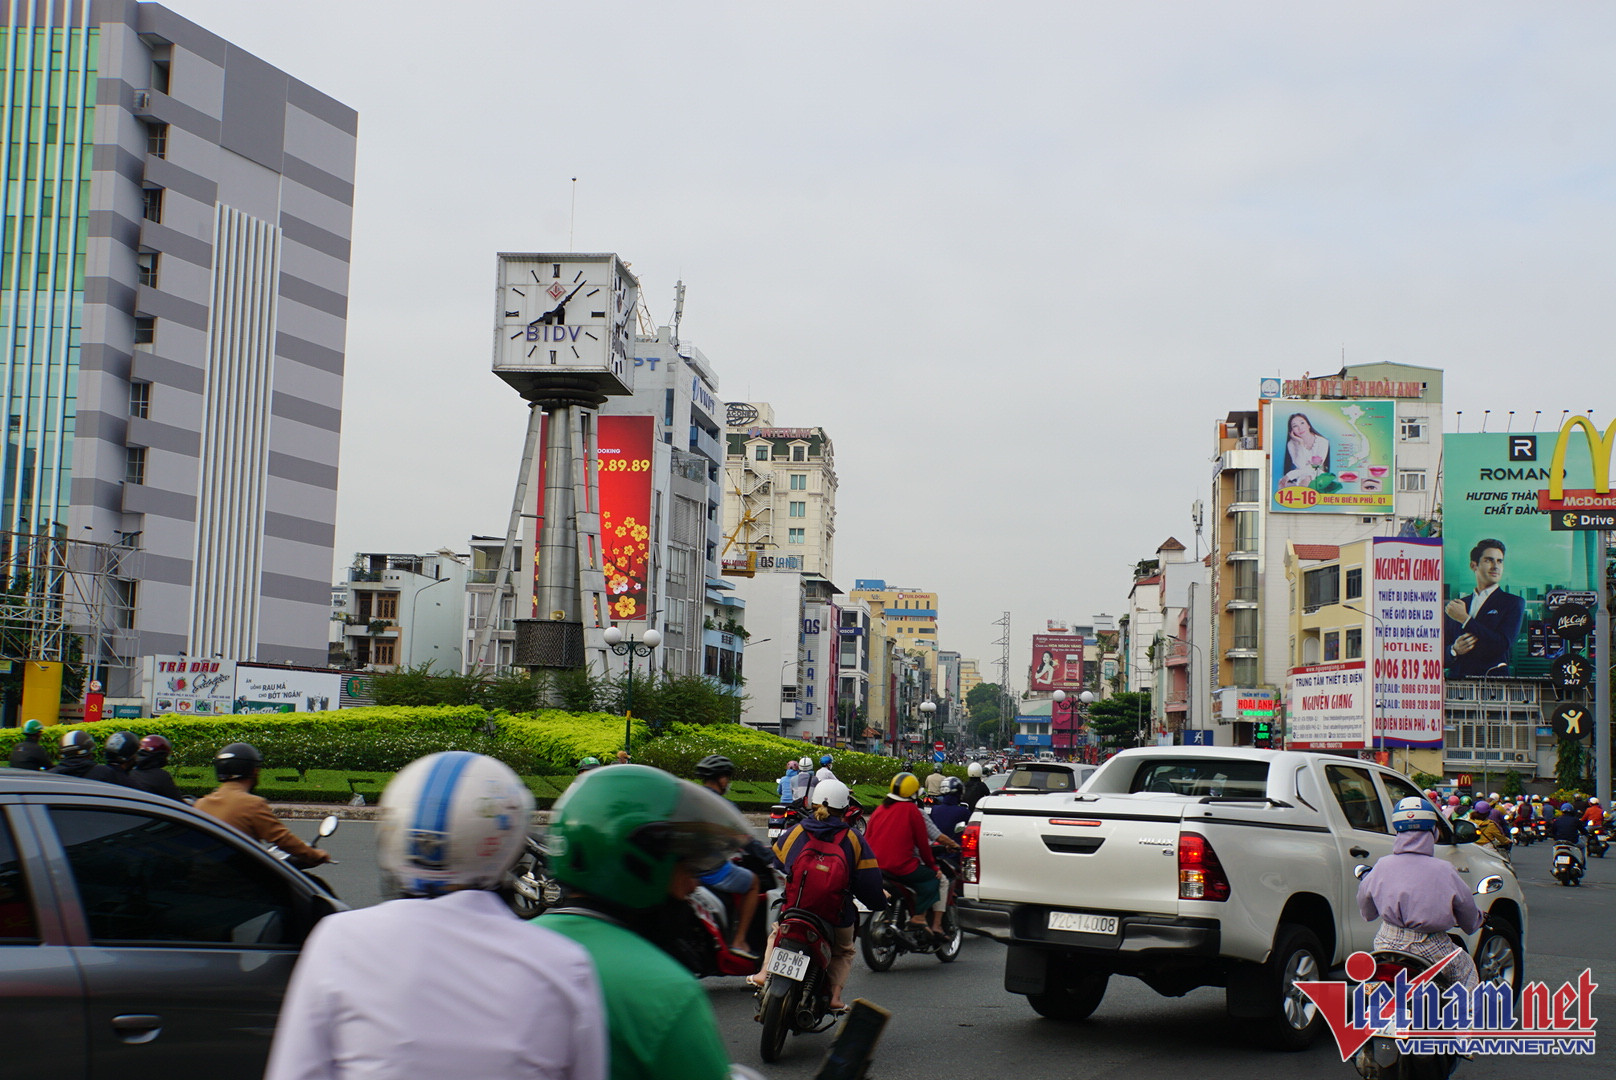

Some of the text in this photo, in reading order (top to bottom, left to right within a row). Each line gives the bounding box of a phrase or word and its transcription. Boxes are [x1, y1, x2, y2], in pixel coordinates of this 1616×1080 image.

[526, 325, 582, 342] BIDV
[1397, 382, 1420, 397] ANH
[1278, 490, 1317, 505] 14-16
[1323, 495, 1338, 504] ĐIỆN
[1340, 495, 1358, 504] BIÊN
[1378, 496, 1387, 505] Q1
[1466, 489, 1539, 501] HƯƠNG THÀN
[1484, 502, 1512, 515] CHẤT
[1580, 515, 1614, 526] Drive
[760, 556, 798, 569] QS LAND
[1375, 550, 1440, 581] NGUYỄN GIANG
[1378, 588, 1395, 602] THIẾT
[1396, 590, 1402, 604] BỊ
[1382, 606, 1393, 619] THẾ
[1408, 607, 1421, 620] ĐÈN
[1422, 609, 1434, 620] LED
[803, 618, 820, 635] QS
[1375, 625, 1392, 638] THẾT
[1400, 626, 1415, 639] ĐIỆN
[1429, 627, 1440, 639] TAY
[1383, 642, 1433, 652] HOTLINE:
[159, 658, 187, 673] TRÀ
[1401, 658, 1420, 680] 819
[1422, 659, 1441, 680] 300
[806, 649, 815, 716] LAND
[1295, 677, 1312, 687] TRUNG
[1313, 674, 1325, 686] TÂM
[1326, 672, 1342, 685] THIẾT
[1349, 671, 1363, 685] ĐIỆN
[1237, 698, 1273, 710] HOÀI ANH
[1302, 689, 1353, 710] NGUYỄN GIANG
[1398, 715, 1413, 730] BIÊN
[1413, 714, 1426, 731] PHỦ
[776, 951, 804, 967] 60-N6
[773, 961, 800, 978] 8281
